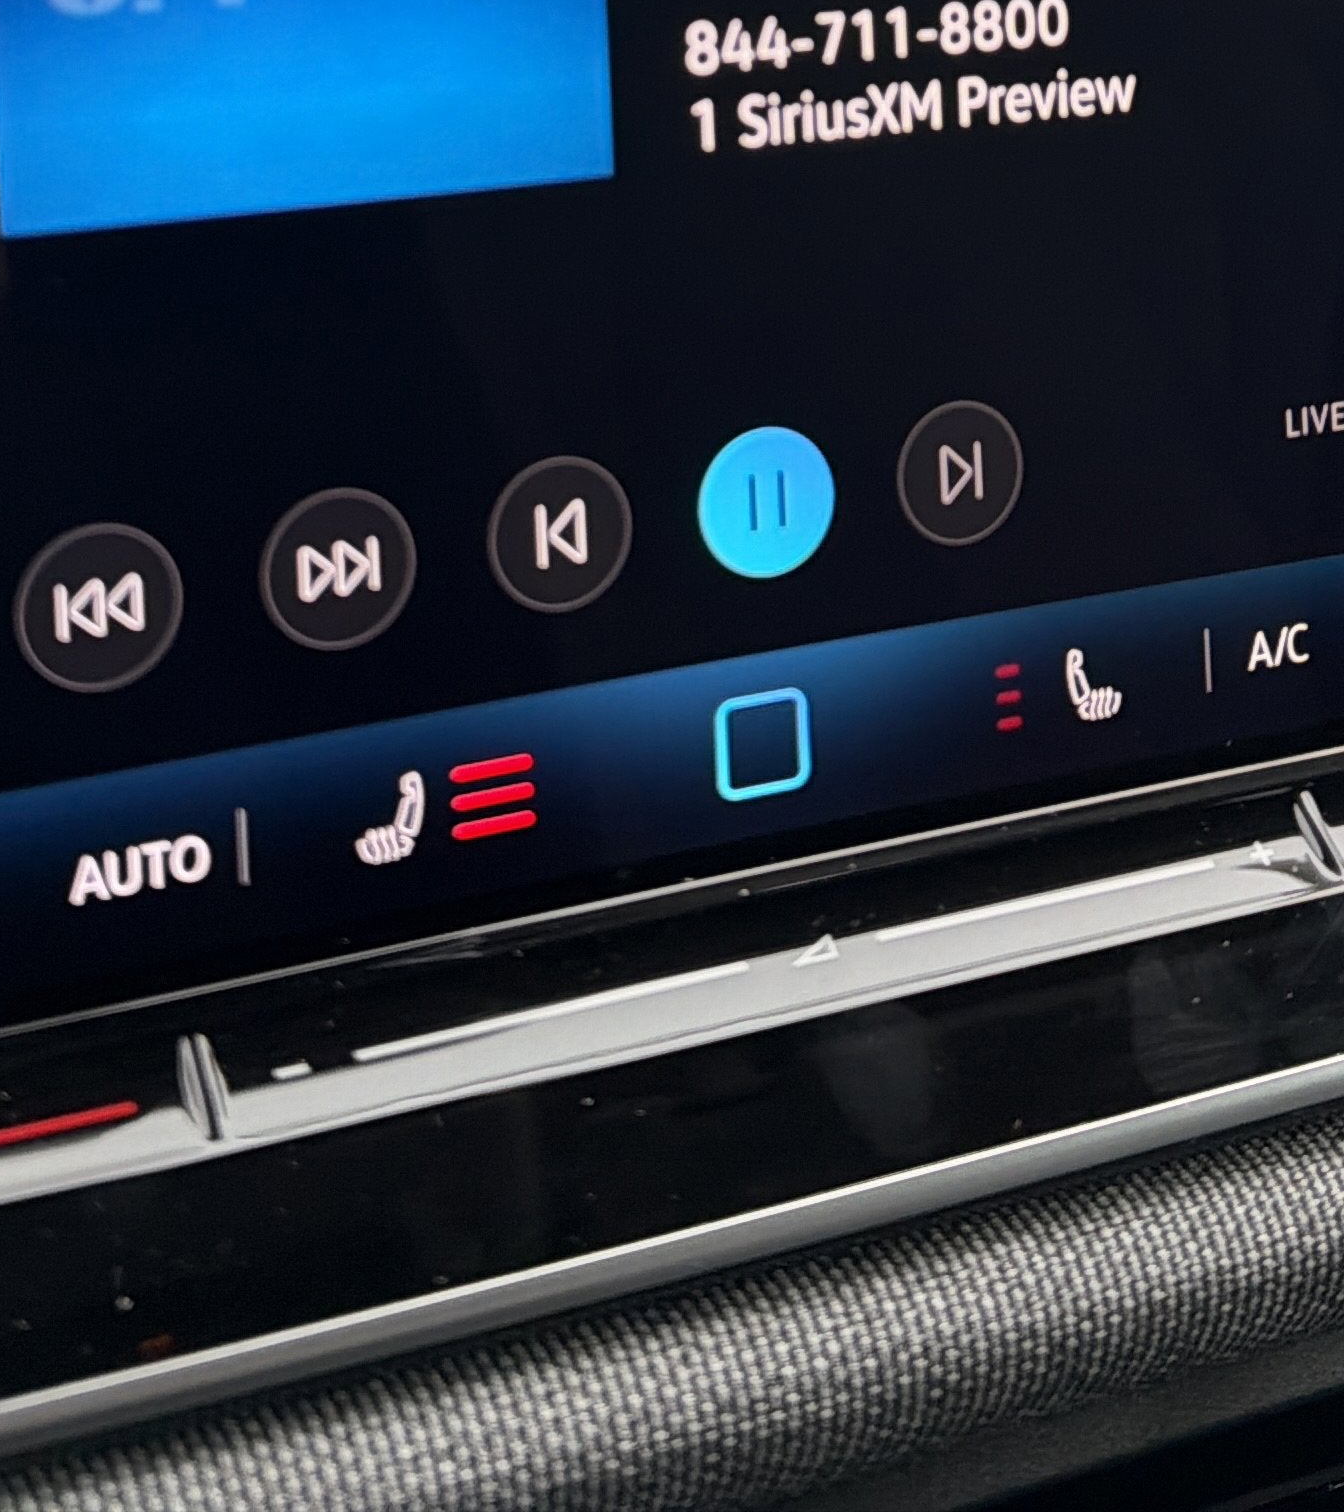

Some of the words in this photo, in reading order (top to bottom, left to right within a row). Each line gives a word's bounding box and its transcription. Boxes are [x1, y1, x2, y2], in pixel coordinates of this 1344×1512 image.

[689, 97, 717, 154] 1
[736, 80, 944, 150] SiriusXM
[956, 66, 1138, 129] Preview
[1246, 621, 1311, 673] A/C
[67, 833, 213, 907] AUTO
